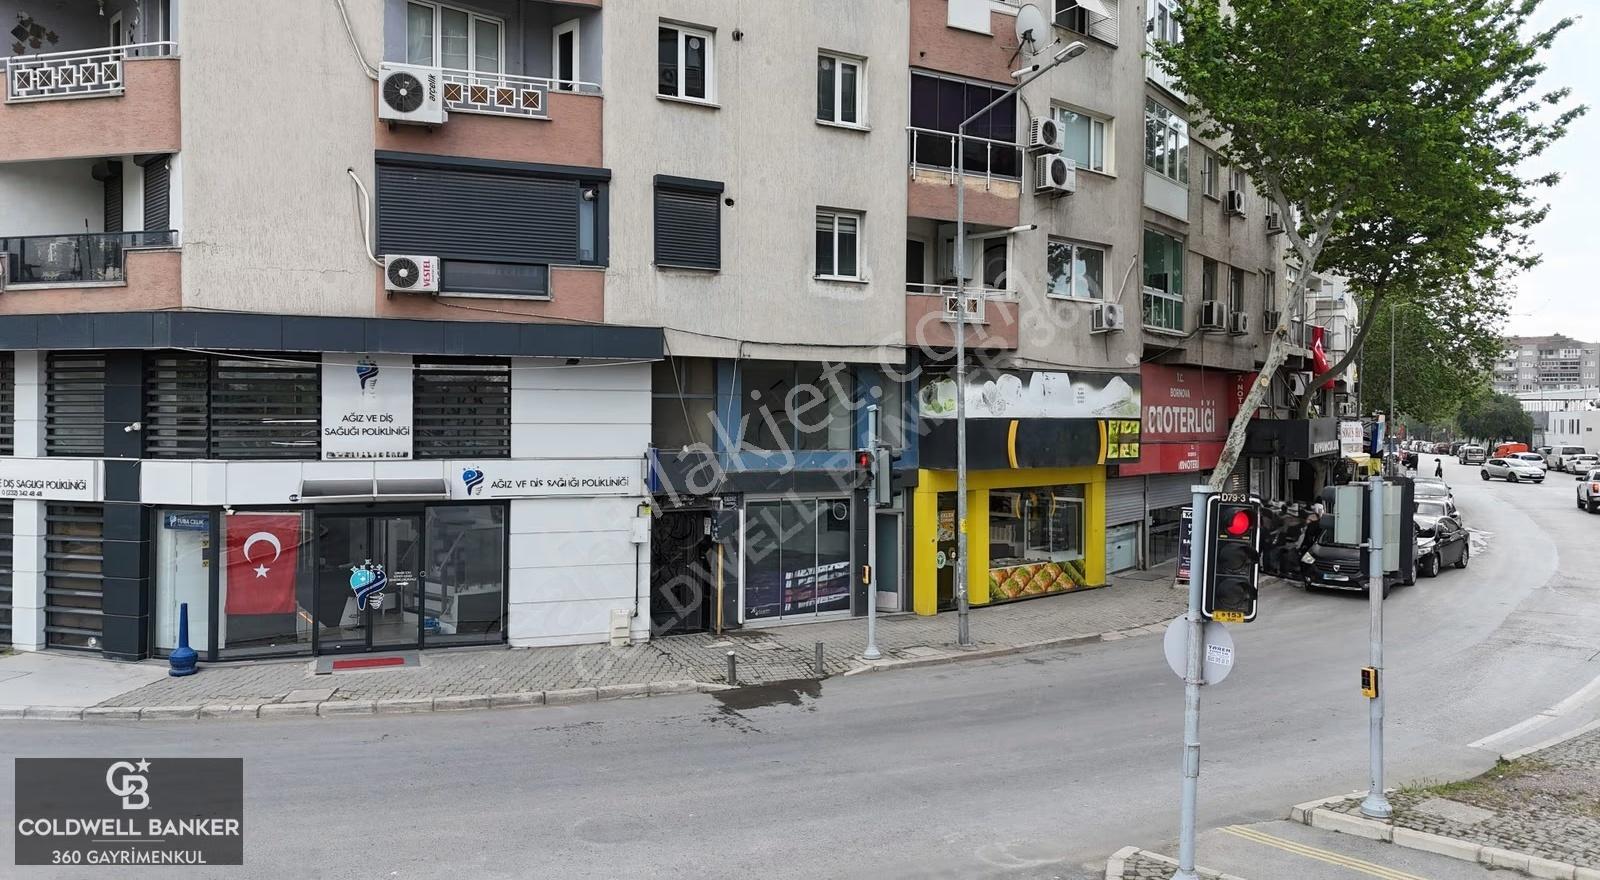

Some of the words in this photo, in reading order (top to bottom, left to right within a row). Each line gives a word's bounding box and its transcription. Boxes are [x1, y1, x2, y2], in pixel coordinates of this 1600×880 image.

[422, 261, 431, 288] VESTEL
[341, 412, 364, 423] AĞIZ
[365, 414, 377, 423] VE
[379, 412, 394, 424] DİŞ
[324, 426, 360, 436] SAĞLIĞI
[361, 426, 410, 436] POLİKLİNİĞİ
[490, 479, 513, 489] AĞIZ
[581, 477, 630, 488] POLİKLİNİĞİ
[1221, 492, 1246, 502] D79-3
